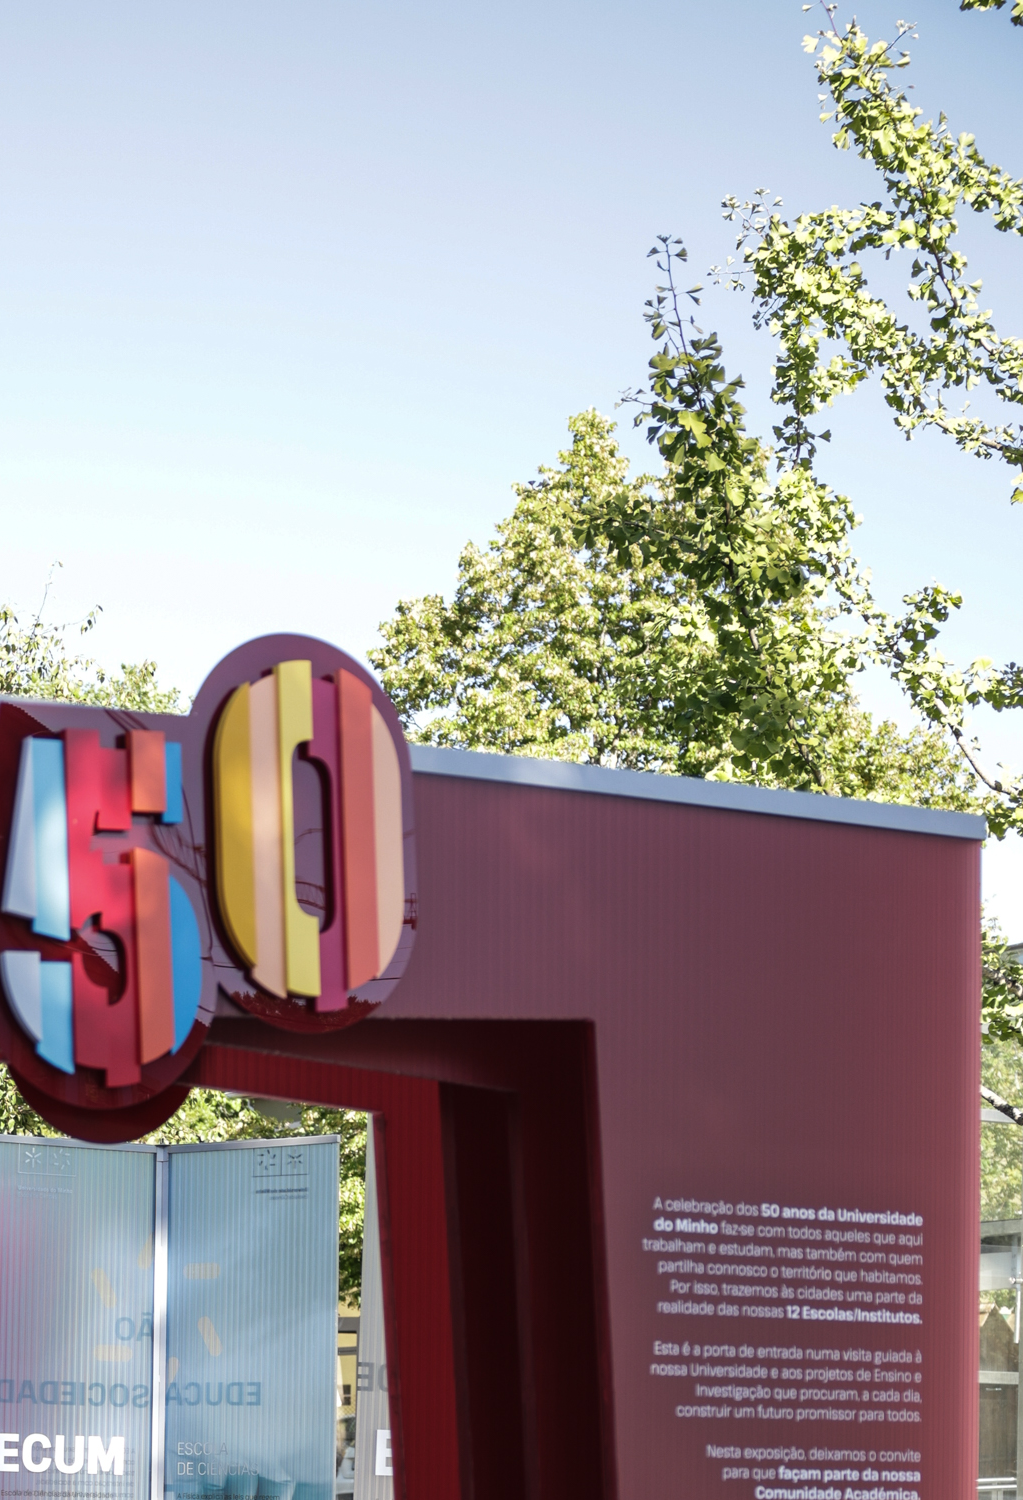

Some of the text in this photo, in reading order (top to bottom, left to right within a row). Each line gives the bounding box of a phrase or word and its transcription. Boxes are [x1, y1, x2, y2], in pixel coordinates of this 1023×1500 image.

[1, 659, 405, 1088] 50
[654, 1197, 923, 1226] A celebração dos 50 anos da Universidade
[654, 1217, 923, 1247] do Minho faz-se com todos aqueles que aqui
[658, 1300, 922, 1324] realidade das nossas 12 Escolas/Institutos.
[696, 1384, 922, 1403] Investigação que procuram, a cada dia,
[676, 1404, 922, 1423] construir um futuro promissor para todos.
[706, 1444, 921, 1462] Nesta exposição, deixamos o convite
[177, 1462, 193, 1476] DE
[723, 1465, 921, 1483] para que façam parte da nossa
[755, 1486, 921, 1500] Comunidade Académica.
